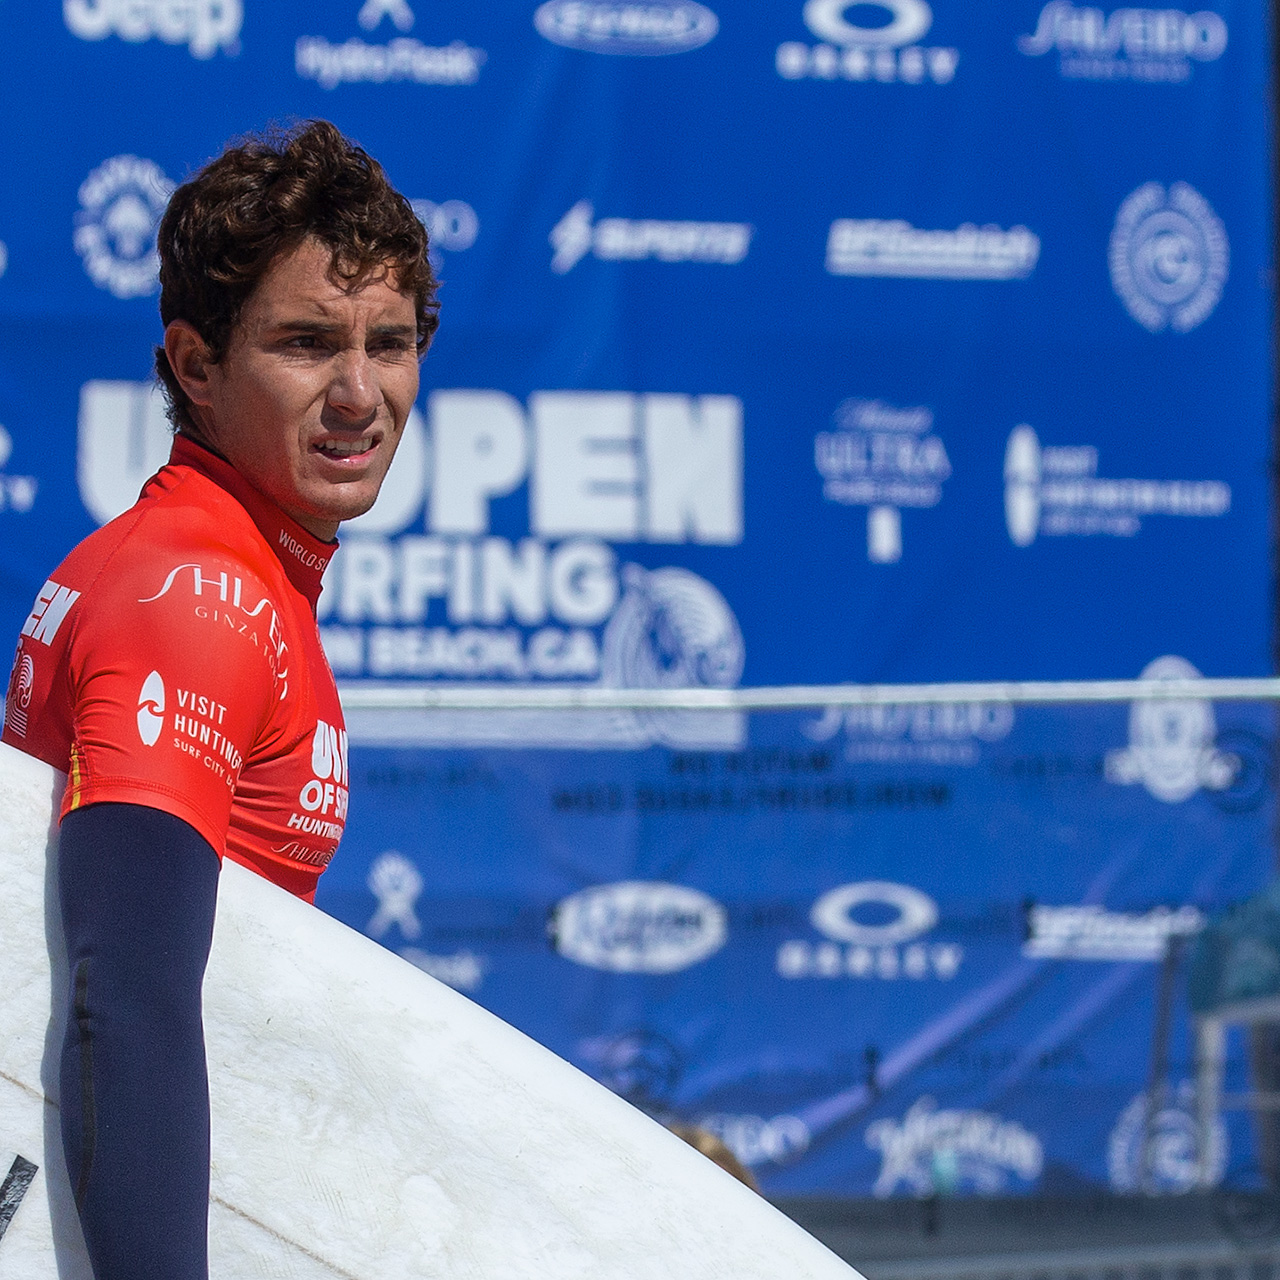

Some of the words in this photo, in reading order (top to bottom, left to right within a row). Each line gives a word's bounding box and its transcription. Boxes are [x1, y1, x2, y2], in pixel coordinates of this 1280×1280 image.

[278, 528, 318, 567] WORLD
[195, 606, 259, 647] GINZA
[177, 688, 228, 725] VISIT
[173, 737, 202, 760] SURF
[204, 756, 226, 778] CITY
[299, 779, 335, 816] OF
